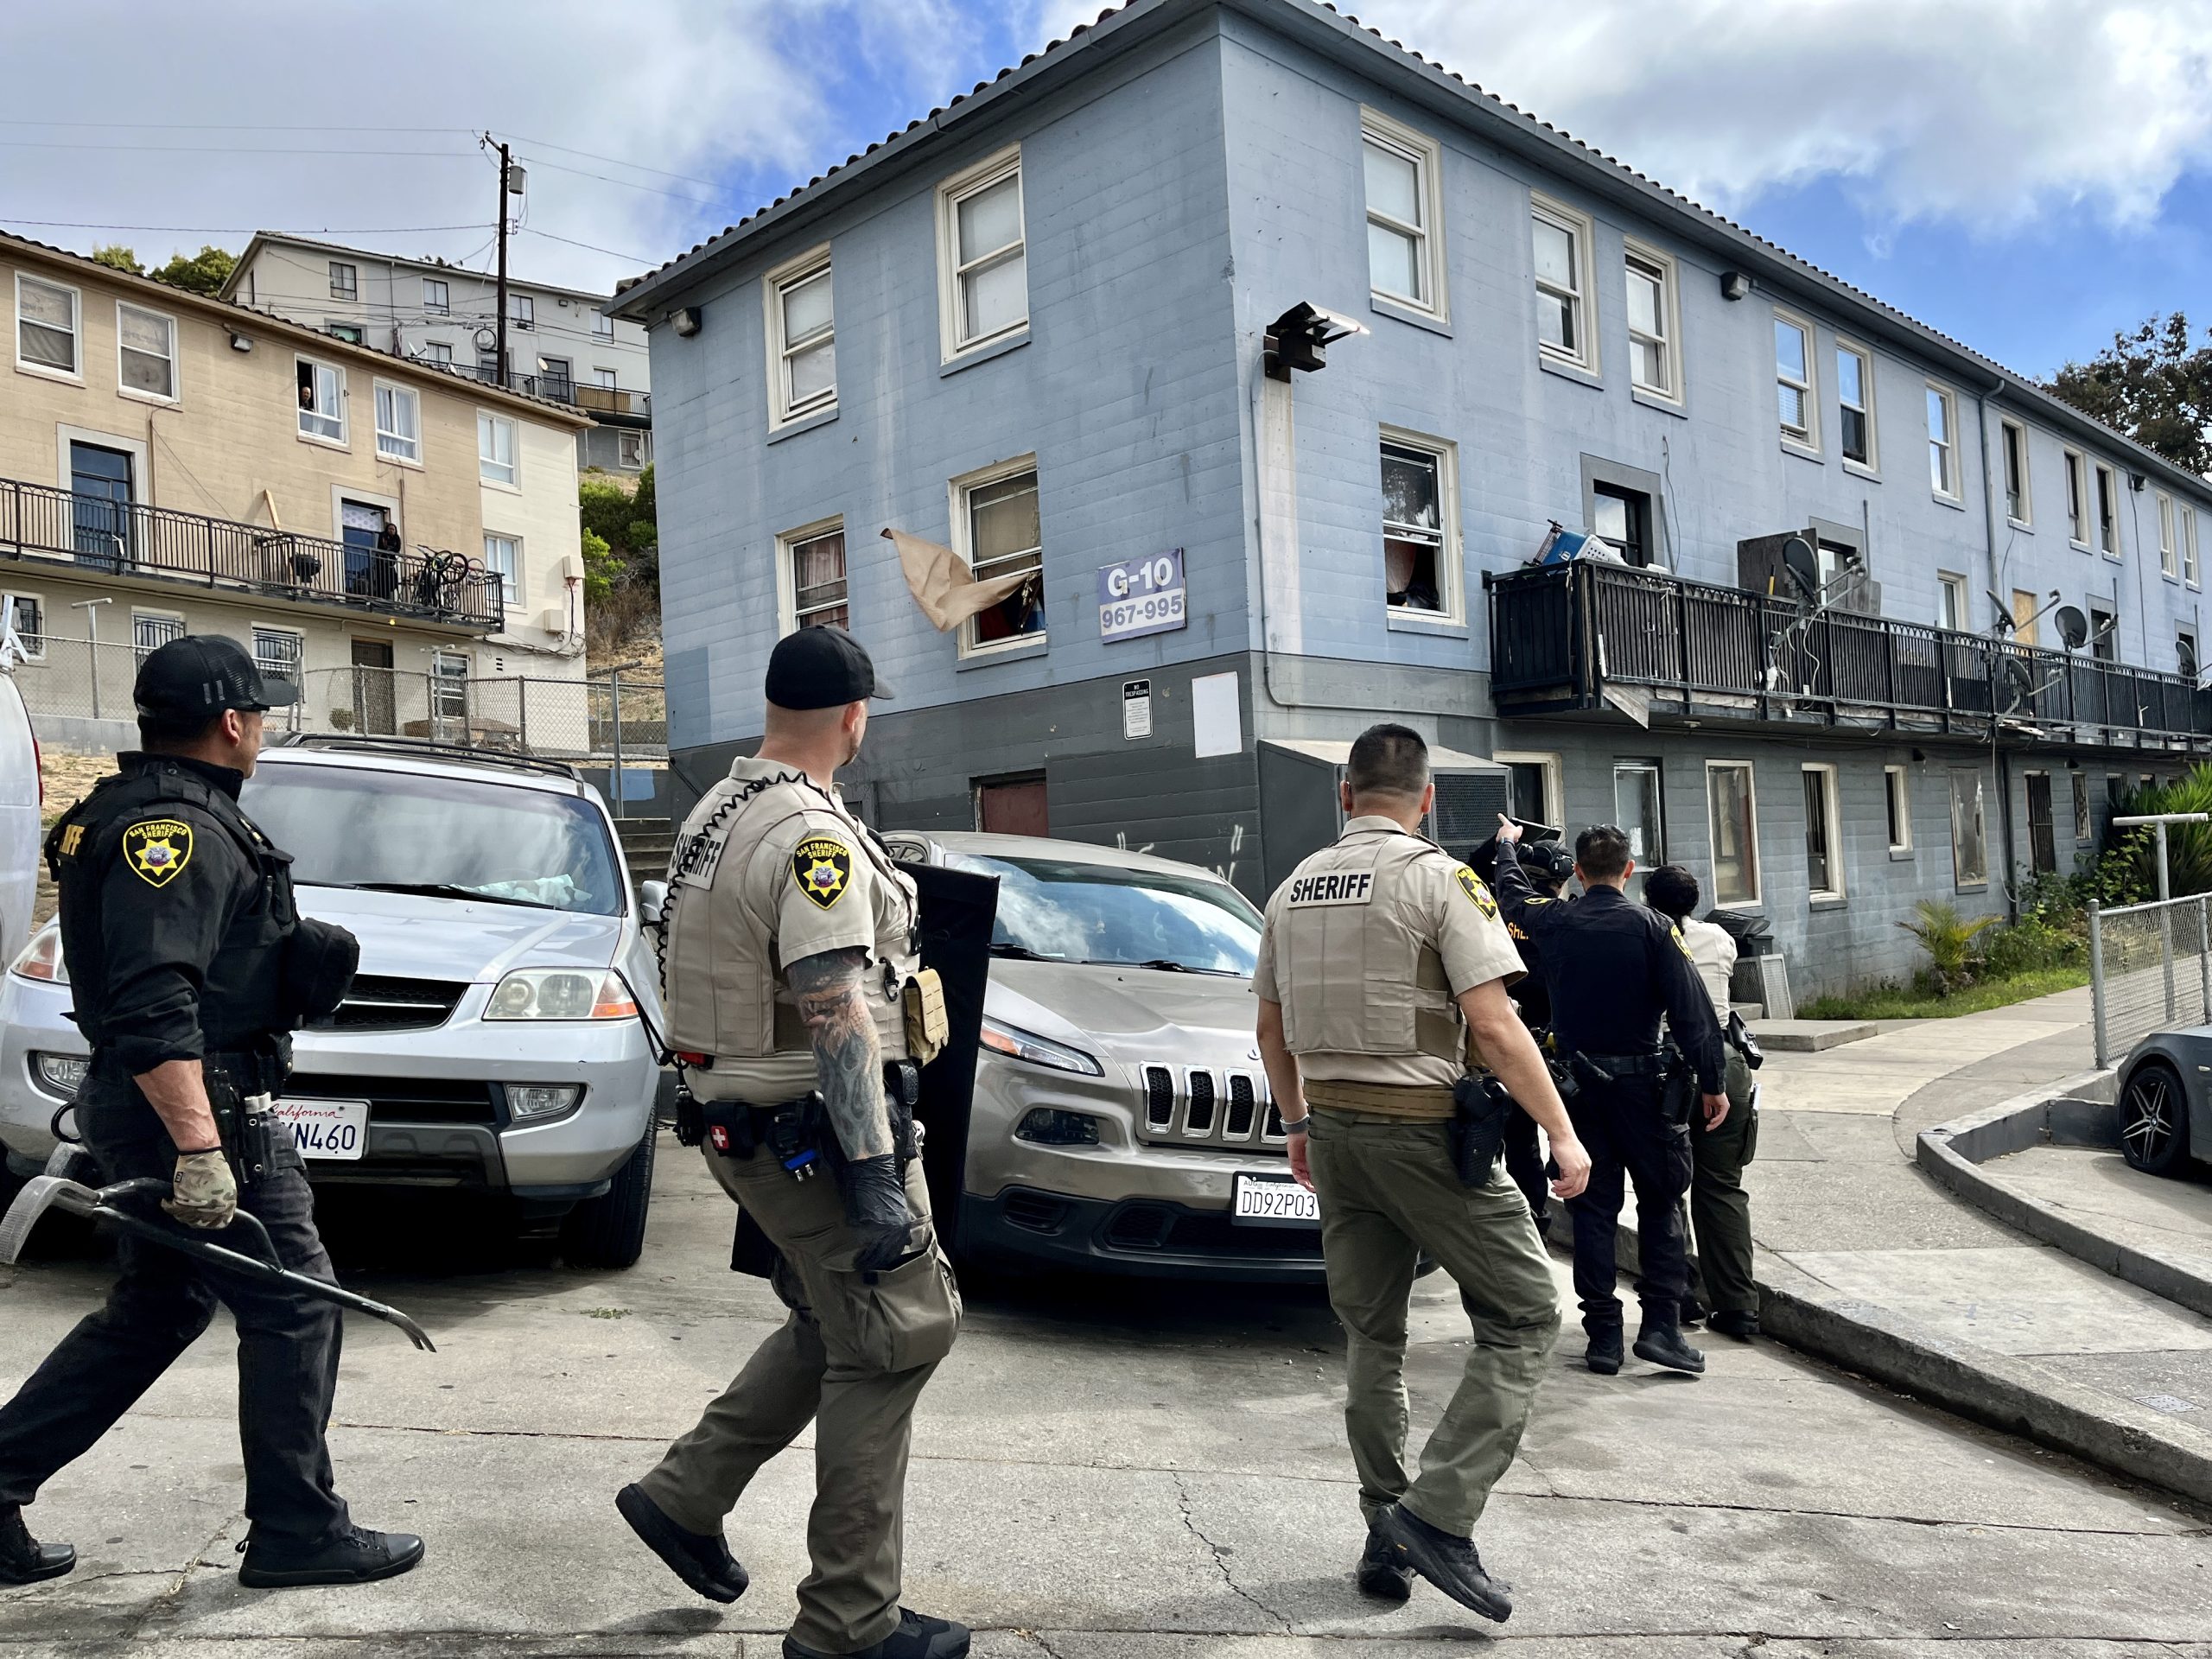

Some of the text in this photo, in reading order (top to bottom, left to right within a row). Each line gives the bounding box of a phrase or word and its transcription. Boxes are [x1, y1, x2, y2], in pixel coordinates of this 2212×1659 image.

[1108, 557, 1173, 597] G-10
[1103, 594, 1183, 629] 967-995
[129, 824, 188, 837] SAN FRANCISCO
[142, 830, 174, 839] SHERIFF
[796, 842, 848, 858] SAN FRANCISCO
[807, 849, 836, 860] SHERIFF
[1290, 874, 1370, 902] SHERIFF
[280, 1122, 356, 1150] N460
[1242, 1192, 1315, 1217] DD92P03
